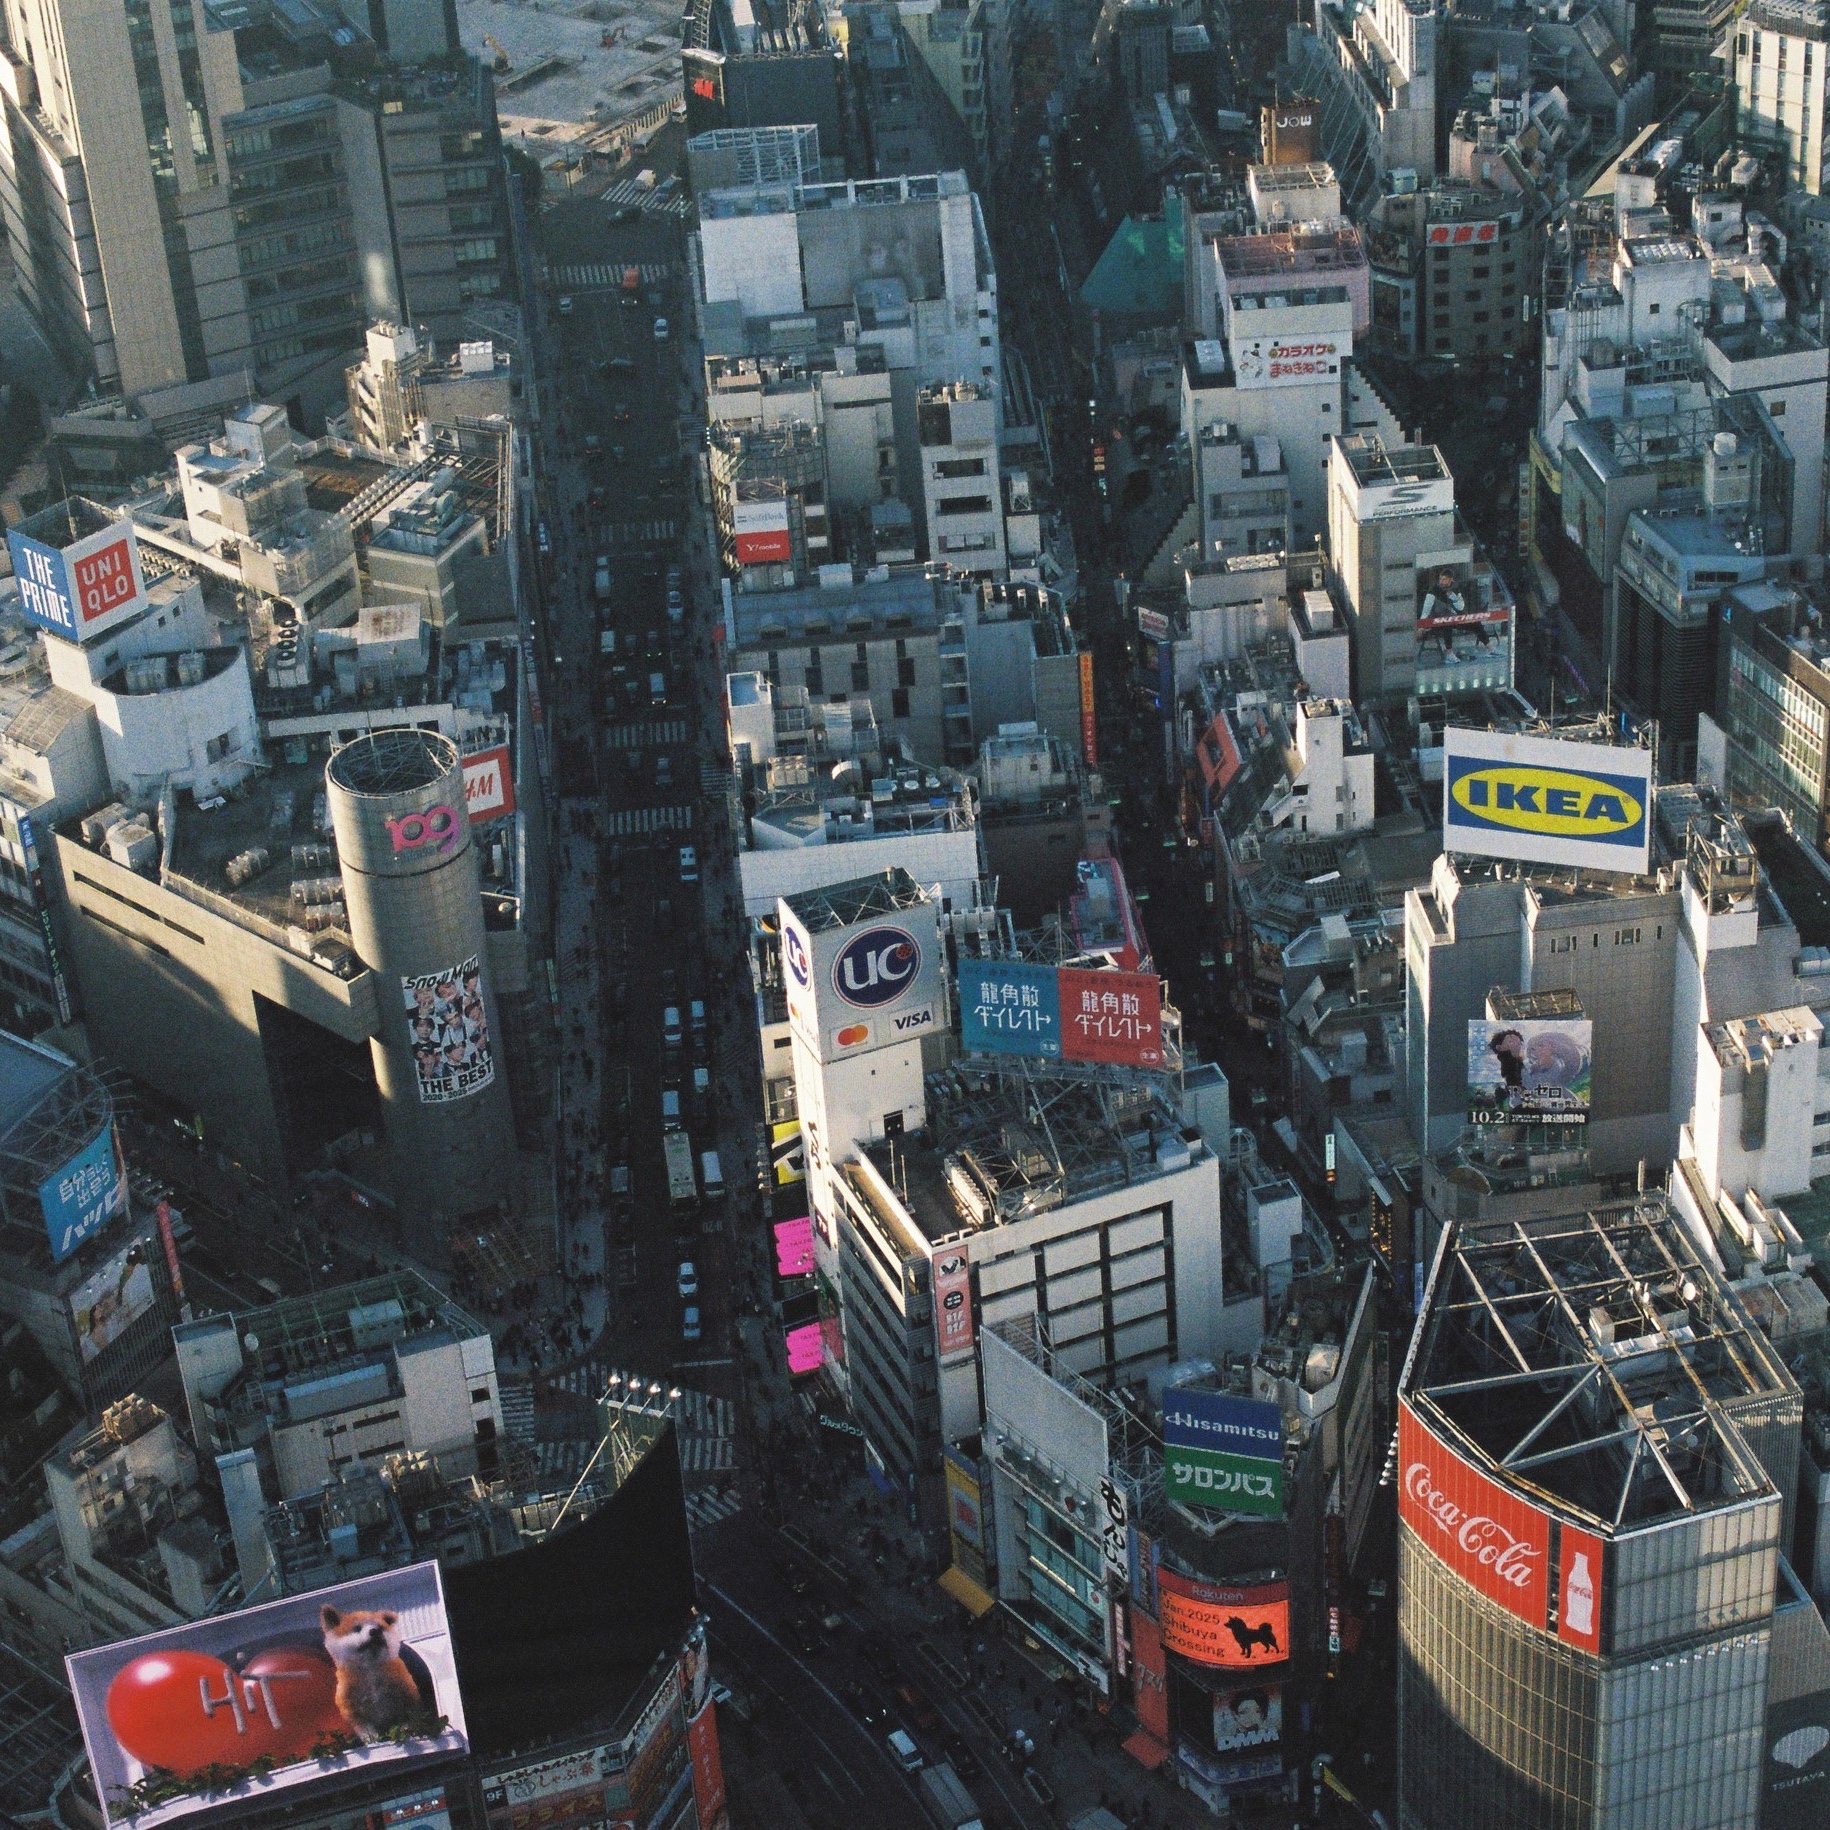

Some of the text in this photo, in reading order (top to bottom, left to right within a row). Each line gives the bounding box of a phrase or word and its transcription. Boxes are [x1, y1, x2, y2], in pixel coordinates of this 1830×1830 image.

[1277, 344, 1328, 358] カラオケ
[1270, 361, 1327, 379] まねきねこ
[1373, 505, 1437, 517] PERFORMANCE
[23, 547, 56, 589] THE
[82, 551, 121, 586] UNI
[20, 577, 72, 628] PRIME
[87, 575, 129, 611] QLO
[1433, 612, 1491, 625] SKECHERS
[1469, 779, 1629, 824] IKEA
[384, 805, 460, 853] 109
[981, 981, 1039, 1007] 龍角散
[1082, 990, 1139, 1015] 龍角散
[894, 1010, 932, 1030] VISA
[974, 1005, 1051, 1031] ダイレクト
[1075, 1014, 1152, 1040] ダイレクト
[421, 1078, 453, 1094] THE
[458, 1058, 492, 1089] BEST
[1471, 1111, 1505, 1124] 10.2
[1542, 1113, 1585, 1124] 放送開始
[1165, 1411, 1279, 1441] Hisamitsu
[1172, 1462, 1275, 1499] サロンパス
[1100, 1480, 1128, 1579] もんじゃ
[1405, 1462, 1542, 1588] Coca-Cola
[1191, 1585, 1244, 1601] Rakuten
[1163, 1598, 1220, 1625] Jan 2025
[1162, 1612, 1217, 1641] Shibuya
[1162, 1627, 1225, 1658] Crossing
[1773, 1770, 1826, 1791] TSUTAYA
